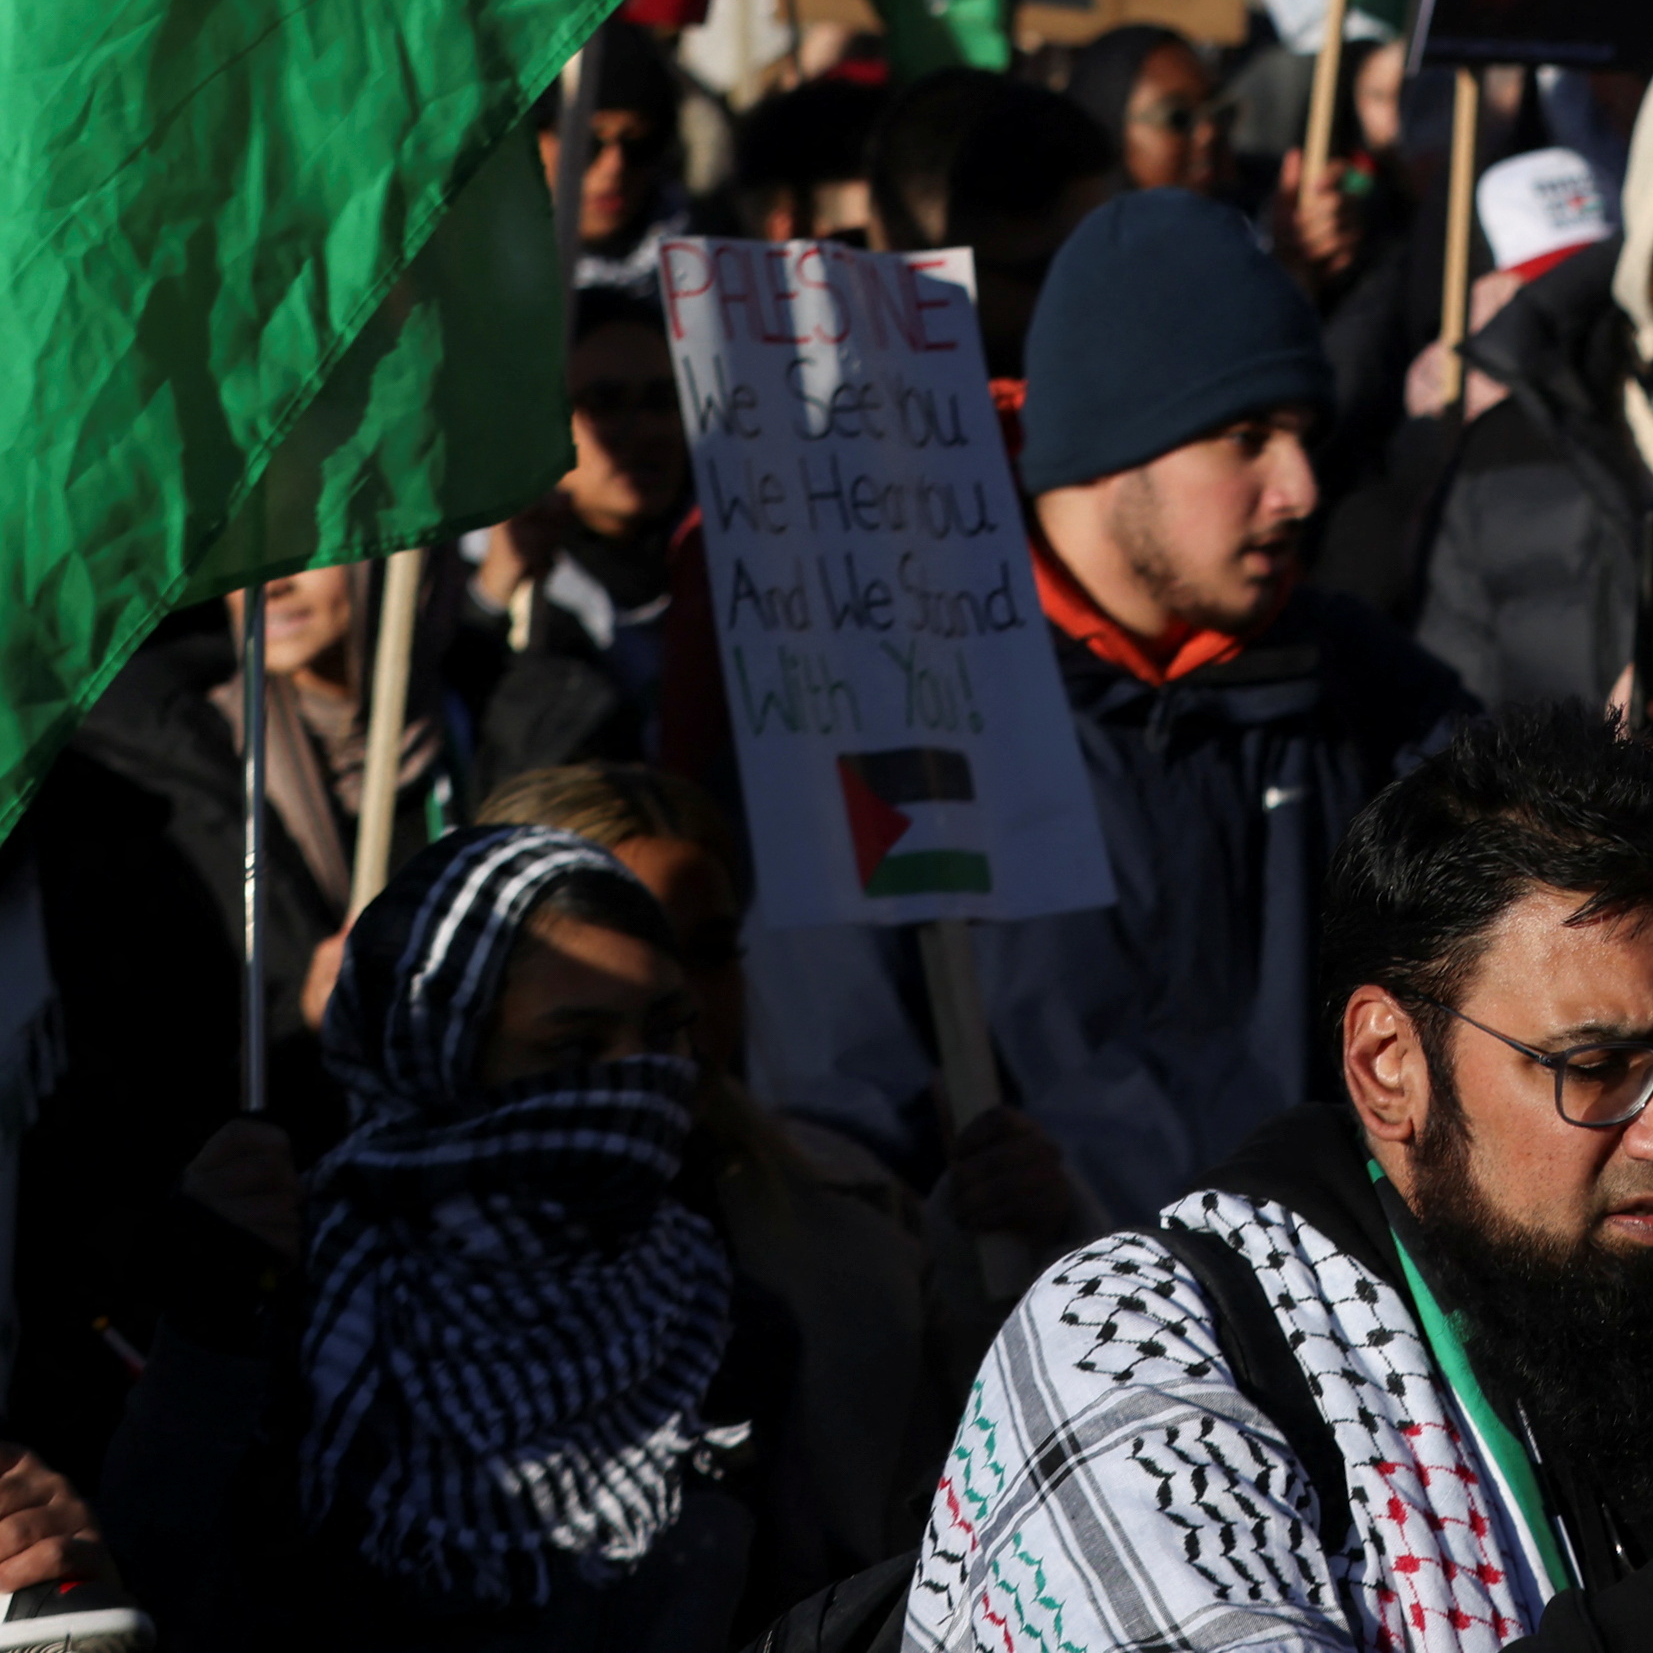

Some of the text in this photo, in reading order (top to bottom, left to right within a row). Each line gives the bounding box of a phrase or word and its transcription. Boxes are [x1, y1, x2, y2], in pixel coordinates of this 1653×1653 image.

[683, 354, 761, 439] We
[786, 357, 885, 441] See
[706, 455, 788, 535] We
[727, 557, 812, 632] And
[818, 552, 894, 632] We
[733, 645, 864, 737] With
